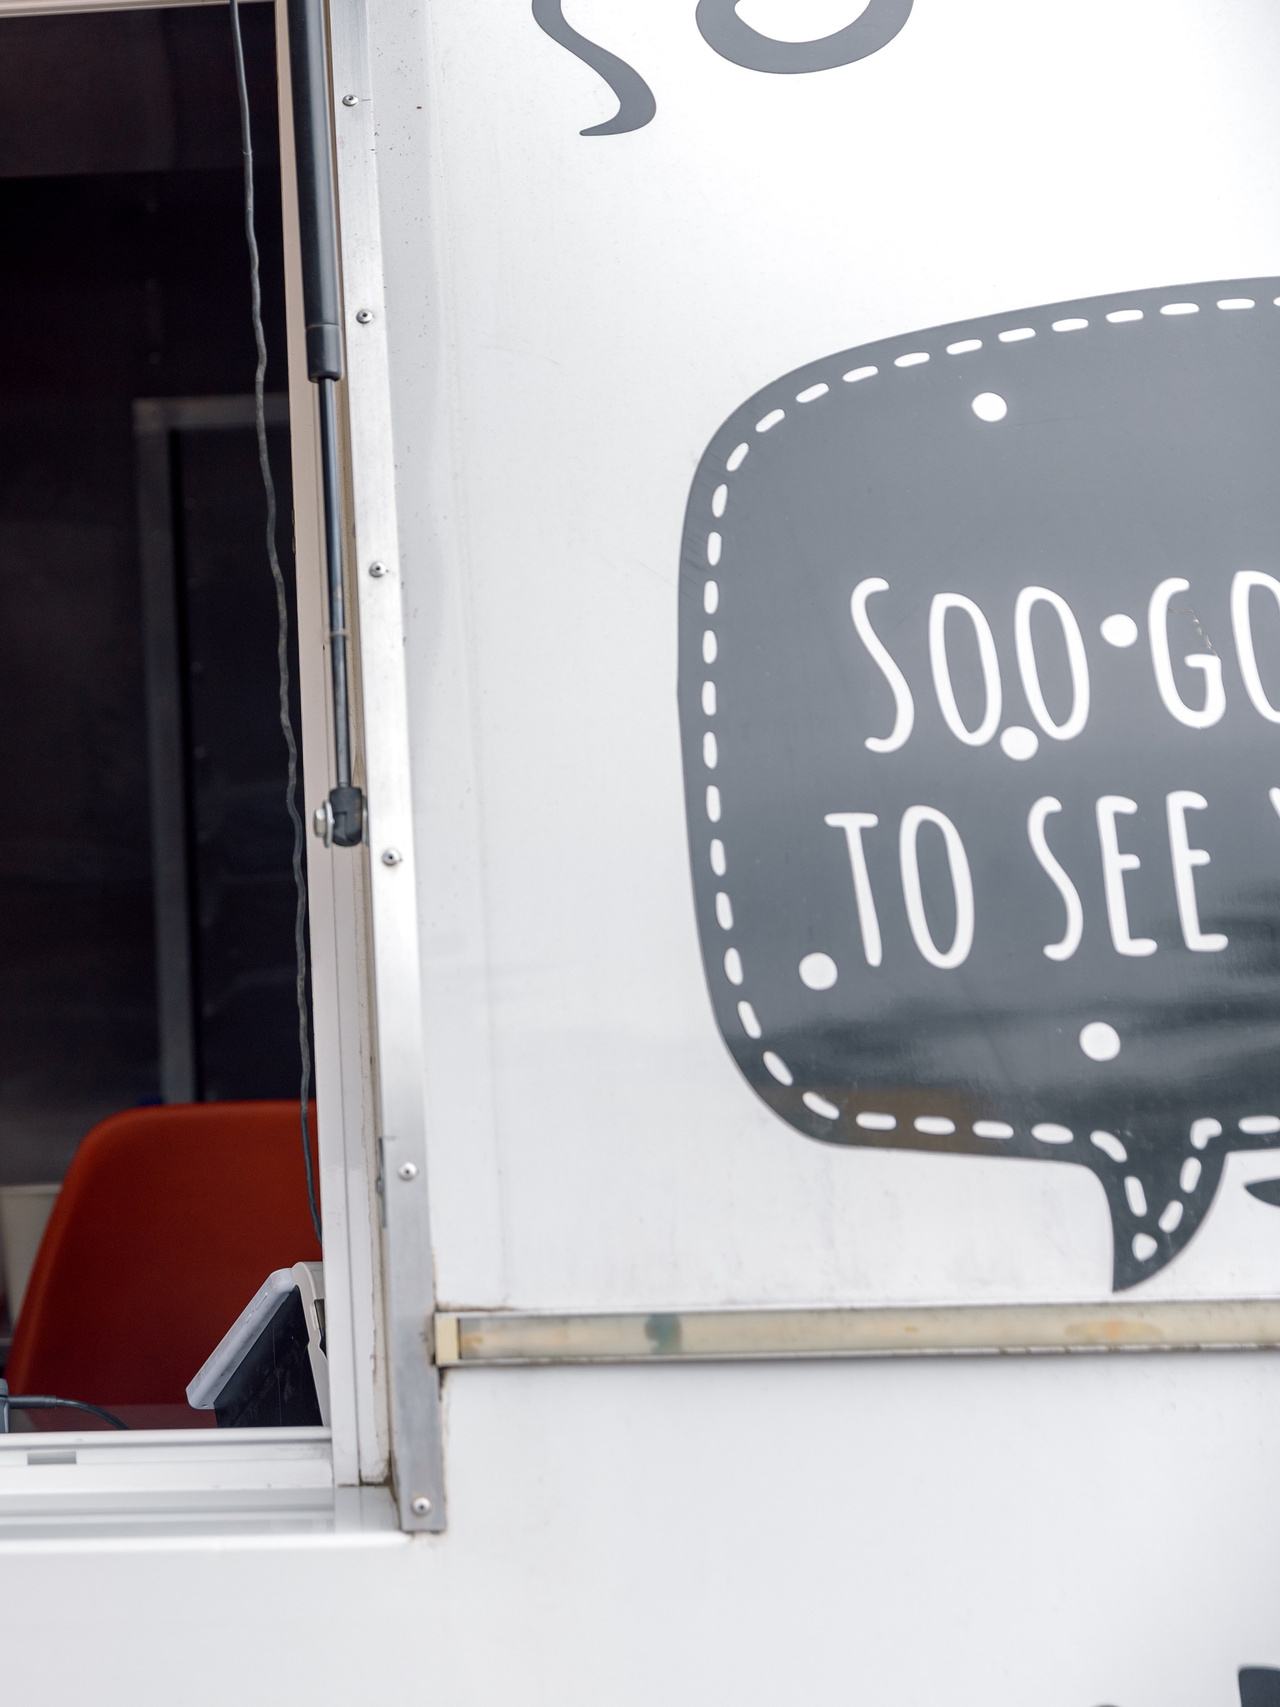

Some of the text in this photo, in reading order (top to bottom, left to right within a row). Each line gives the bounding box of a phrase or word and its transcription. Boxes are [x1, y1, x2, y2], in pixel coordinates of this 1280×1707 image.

[850, 577, 1090, 753] SOO
[824, 790, 1228, 969] TO SEE
